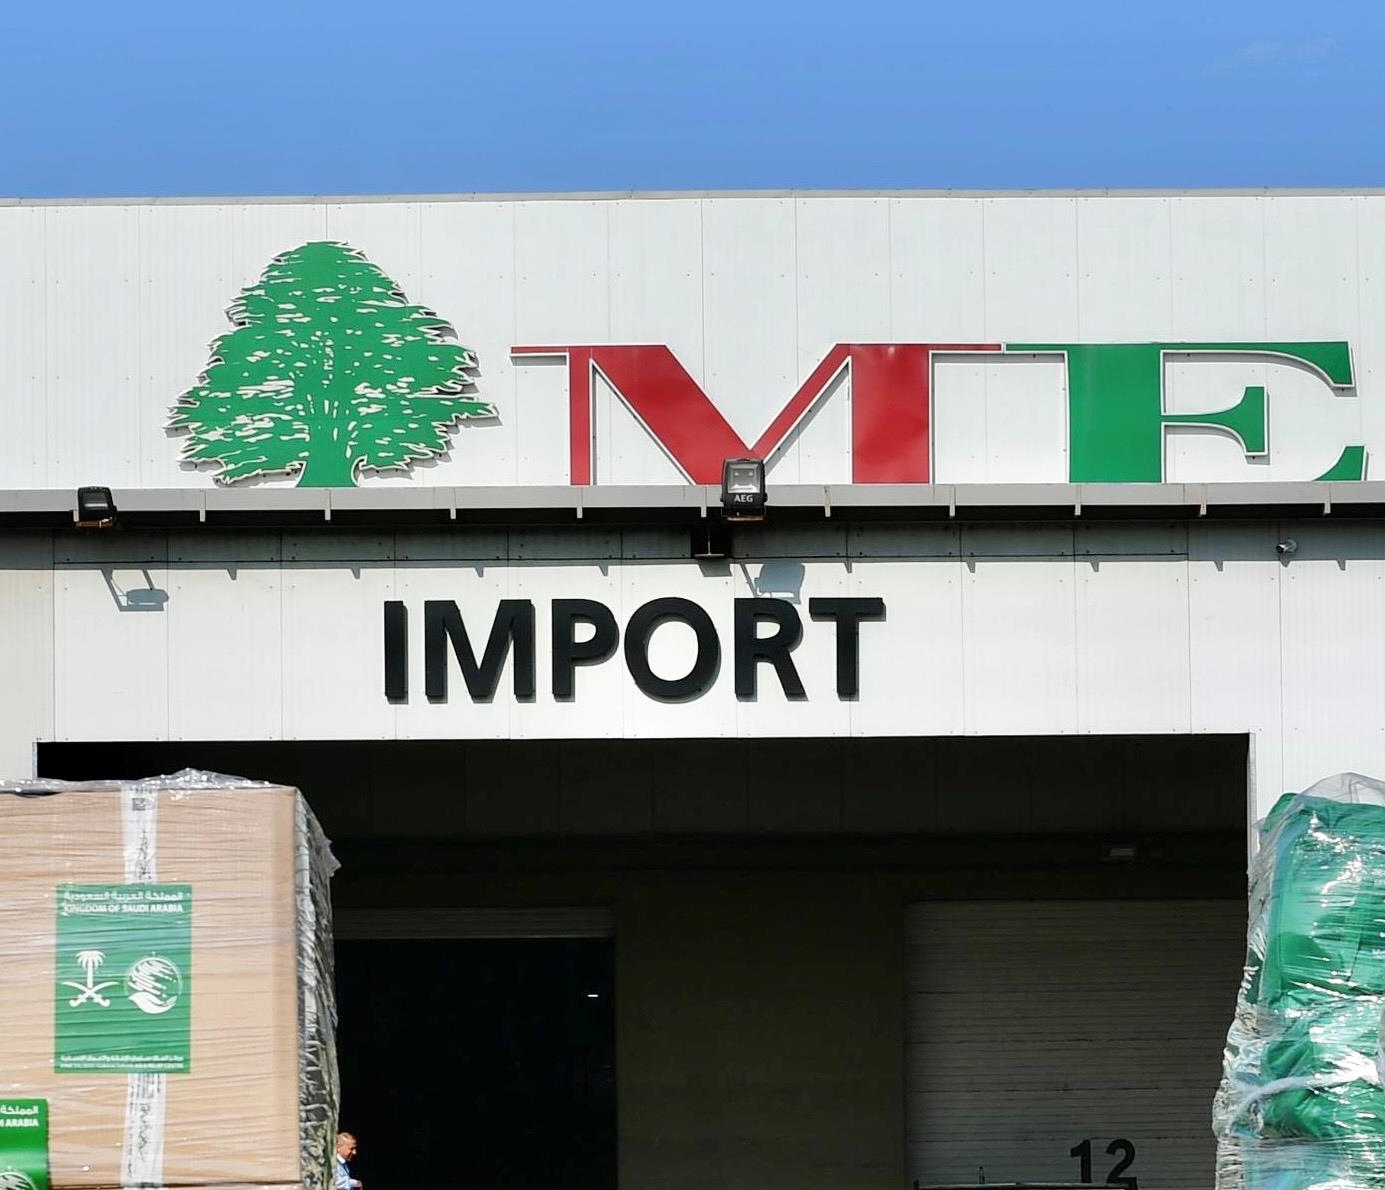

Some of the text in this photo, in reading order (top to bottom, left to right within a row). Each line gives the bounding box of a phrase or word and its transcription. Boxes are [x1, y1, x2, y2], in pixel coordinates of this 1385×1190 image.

[734, 494, 753, 503] AEG
[384, 597, 885, 702] IMPORT
[64, 903, 184, 913] KINGDOM OF SAUDI ARABIA
[0, 1105, 39, 1116] المملكة
[5, 1118, 39, 1128] ARABIA
[1070, 1139, 1137, 1184] 12
